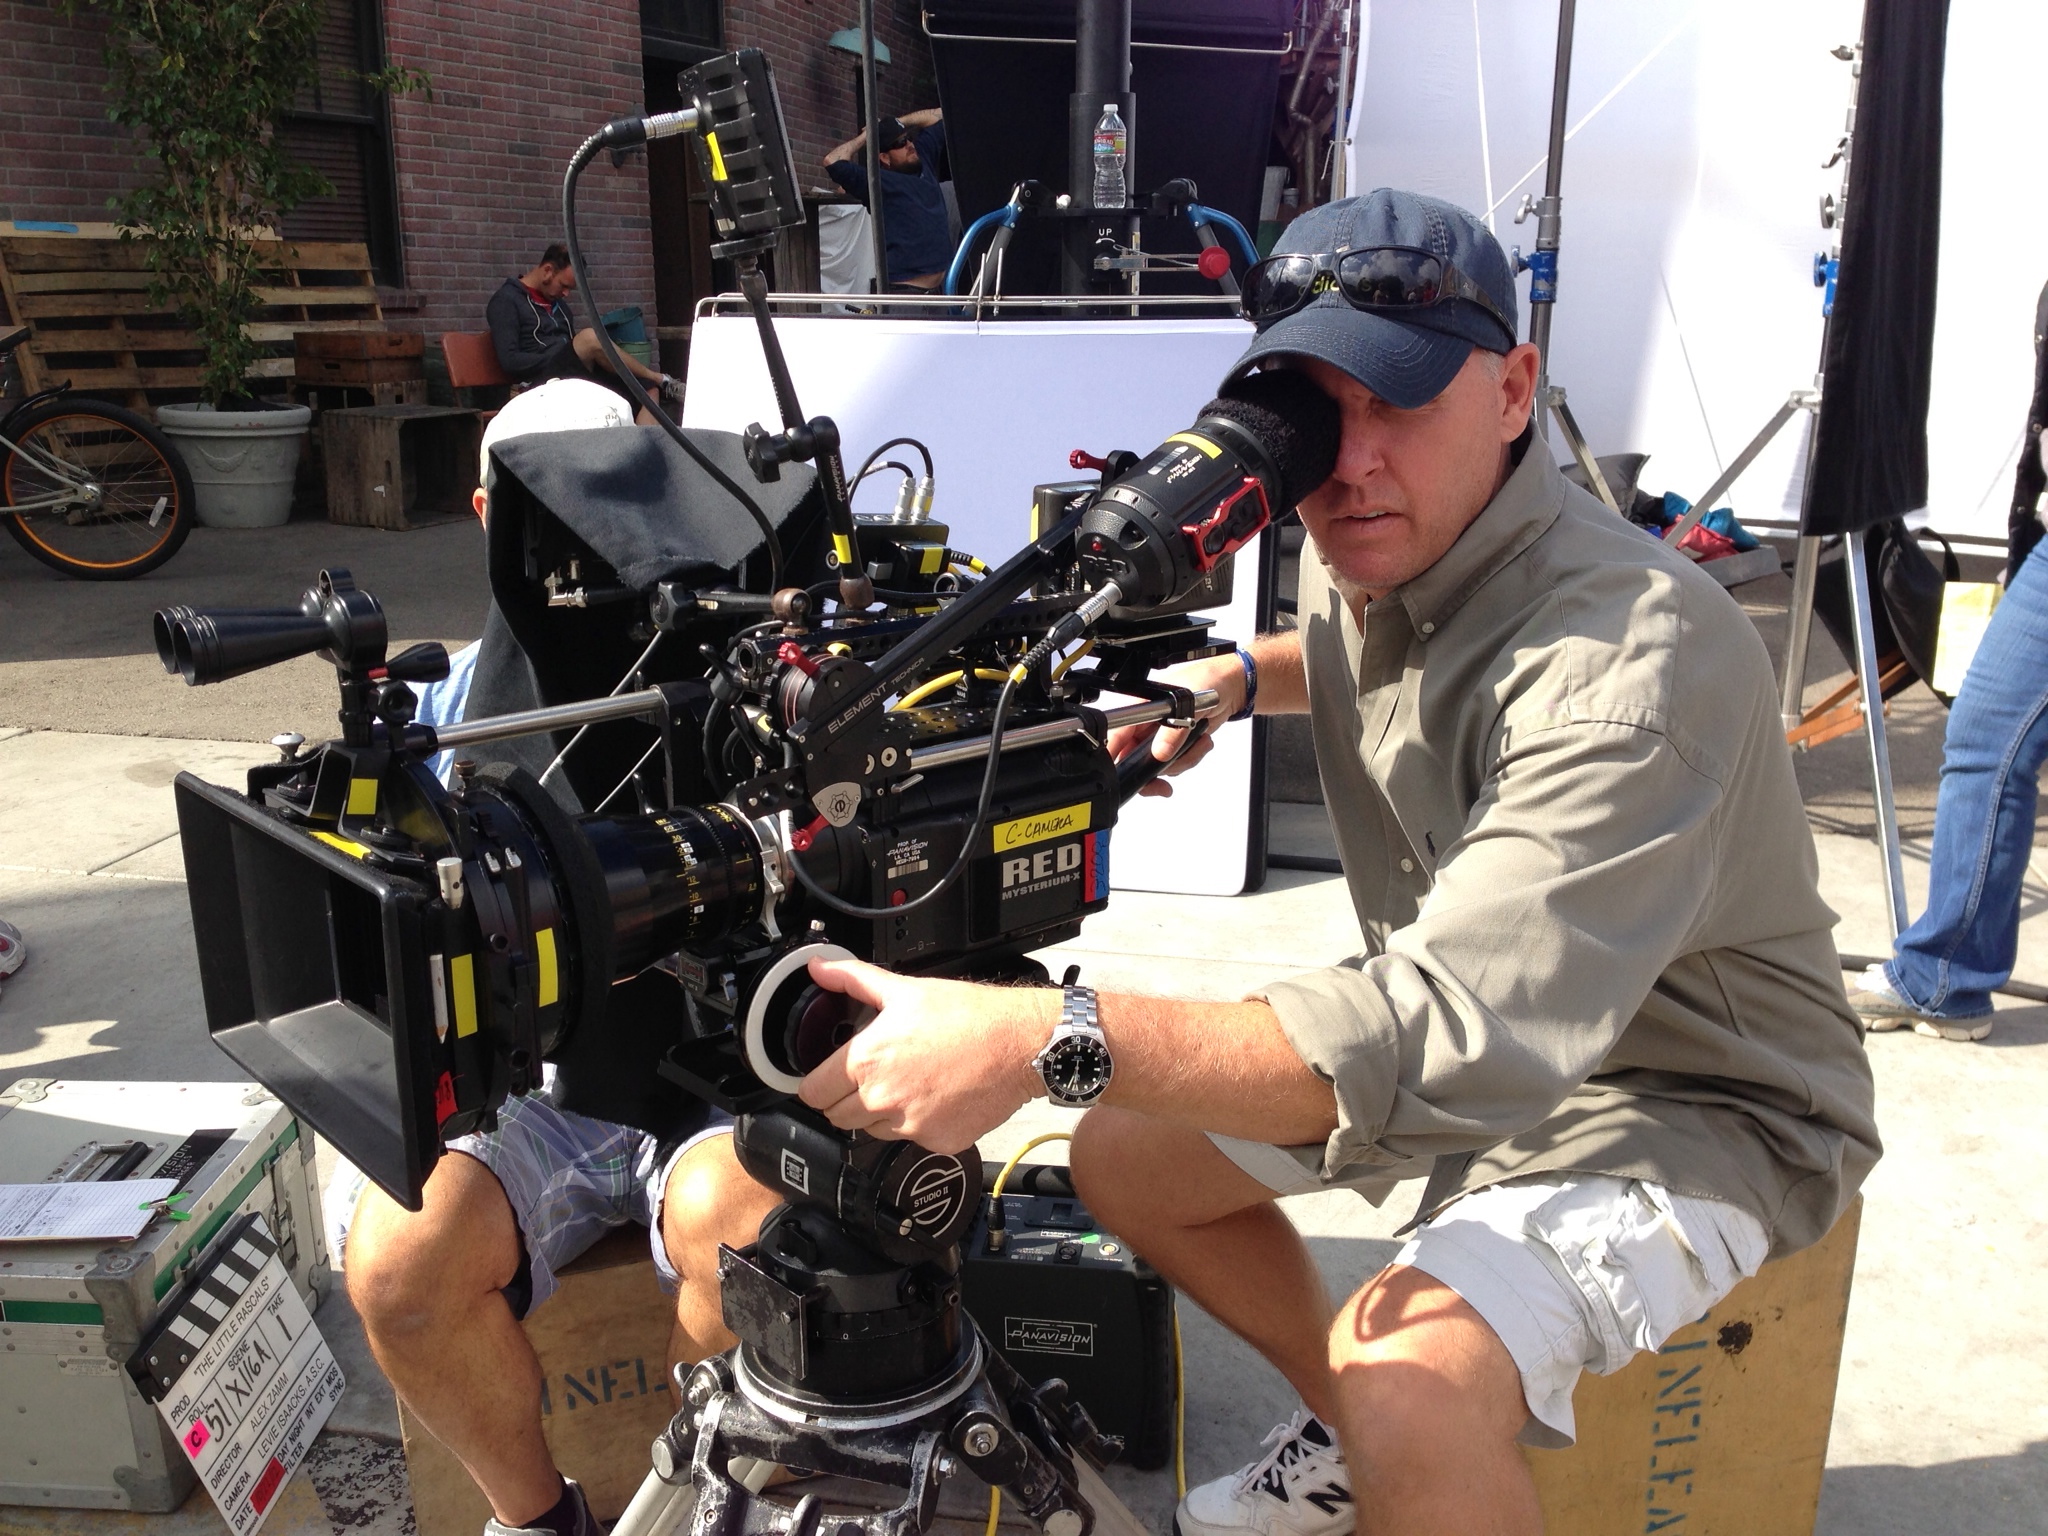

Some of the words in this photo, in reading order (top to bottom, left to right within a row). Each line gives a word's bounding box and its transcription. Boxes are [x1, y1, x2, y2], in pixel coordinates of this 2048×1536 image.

[1098, 228, 1113, 236] UP
[828, 682, 887, 734] ELEMENT
[891, 657, 925, 685] TECHNICA
[1005, 814, 1075, 845] C-CAMERA
[1003, 843, 1081, 888] RED
[1002, 872, 1080, 901] MYSTERIUM-X
[913, 1189, 942, 1208] STUDIO
[267, 1292, 285, 1316] TAKE
[216, 1320, 239, 1357] LITTLE
[276, 1314, 292, 1341] 1
[1008, 1330, 1091, 1344] PANAVISION
[228, 1340, 250, 1371] SCENE
[250, 1404, 270, 1432] ALEX
[269, 1372, 290, 1405] ZAMM
[329, 1378, 344, 1402] SYNC
[170, 1394, 191, 1423] PROD
[188, 1400, 210, 1425] ROLL
[277, 1443, 290, 1463] DAY
[289, 1419, 307, 1444] NIGHT
[305, 1404, 317, 1420] INT
[314, 1385, 327, 1405] EXT
[325, 1367, 339, 1387] MOS
[1645, 1311, 1710, 1536] INELEA
[190, 1430, 203, 1448] C
[258, 1427, 280, 1459] LEVIE
[210, 1442, 242, 1490] DIRECTOR
[284, 1441, 304, 1475] FILTER
[224, 1470, 251, 1511] CAMERA
[235, 1502, 253, 1531] DATE
